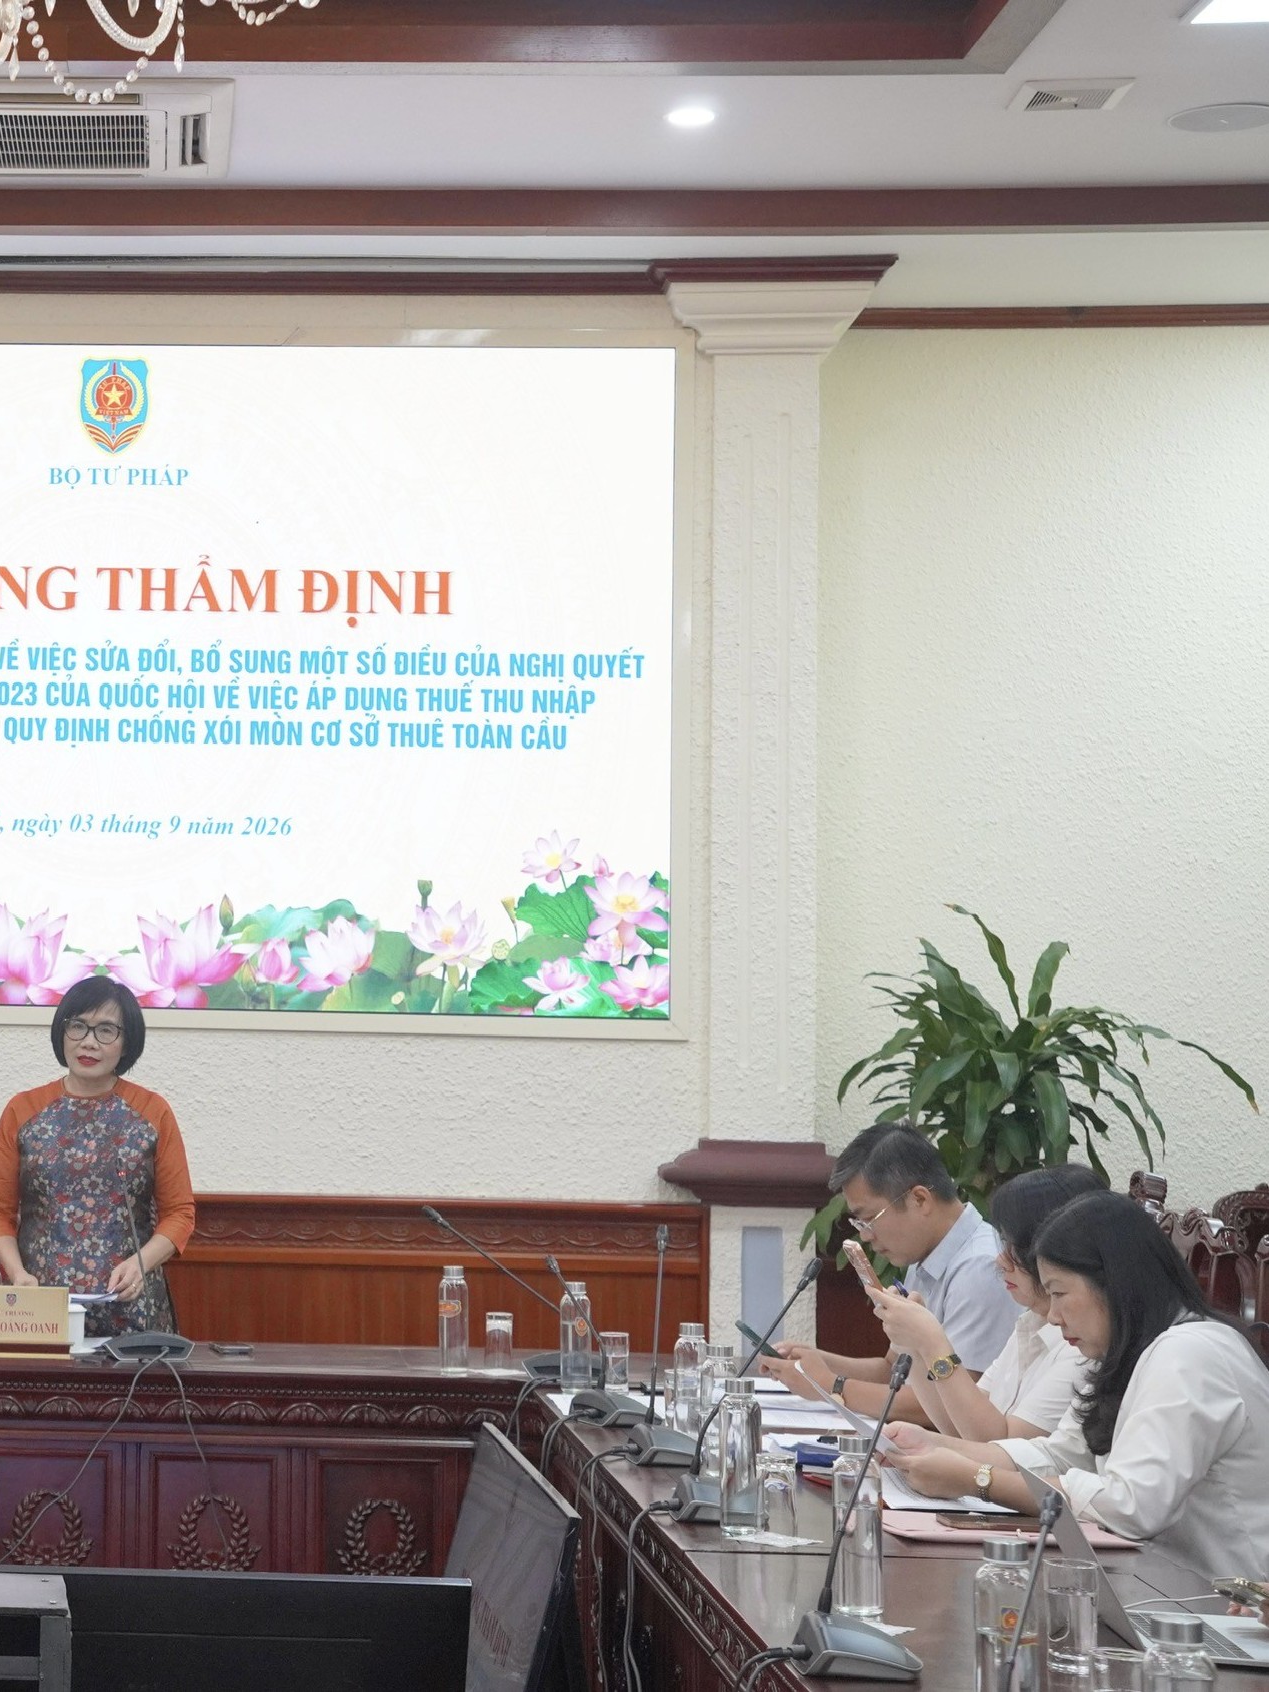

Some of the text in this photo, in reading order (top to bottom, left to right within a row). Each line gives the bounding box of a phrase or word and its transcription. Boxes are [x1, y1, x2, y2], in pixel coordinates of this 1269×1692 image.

[49, 464, 188, 489] BỘ TƯ PHÁP
[97, 554, 278, 614] THẨM
[298, 568, 453, 628] ĐỊNH
[28, 642, 77, 676] VIỆC
[85, 640, 129, 672] SỬA
[138, 638, 182, 675] ĐỔI,
[191, 639, 222, 673] BỔ
[229, 649, 291, 674] SUNG
[300, 645, 348, 679] MỘT
[357, 643, 387, 675] SỐ
[394, 644, 446, 676] ĐIỀU
[455, 644, 501, 676] CỦA
[510, 653, 564, 682] NGHỊ
[573, 647, 645, 680] QUYẾT
[46, 674, 91, 707] CỦA
[99, 674, 159, 709] QUỐC
[168, 678, 205, 714] HỘI
[214, 676, 240, 709] VỀ
[249, 680, 298, 715] VIỆC
[306, 680, 337, 710] ÁP
[345, 687, 407, 715] DỤNG
[416, 680, 474, 712] THUẾ
[481, 689, 523, 713] THU
[532, 685, 596, 719] NHẬP
[4, 717, 47, 744] QUY
[55, 717, 110, 748] ĐỊNH
[118, 711, 196, 744] CHỐNG
[203, 715, 241, 746] XÓI
[250, 714, 303, 746] MÒN
[311, 719, 342, 746] CƠ
[350, 714, 380, 747] SỞ
[452, 720, 513, 749] TOÀN
[521, 717, 567, 750] CẦU
[12, 814, 62, 838] ngày
[69, 814, 93, 832] 03
[100, 814, 162, 839] tháng
[169, 816, 181, 834] 9
[188, 816, 234, 836] năm
[241, 817, 293, 836] 2026
[30, 1323, 58, 1334] OANH
